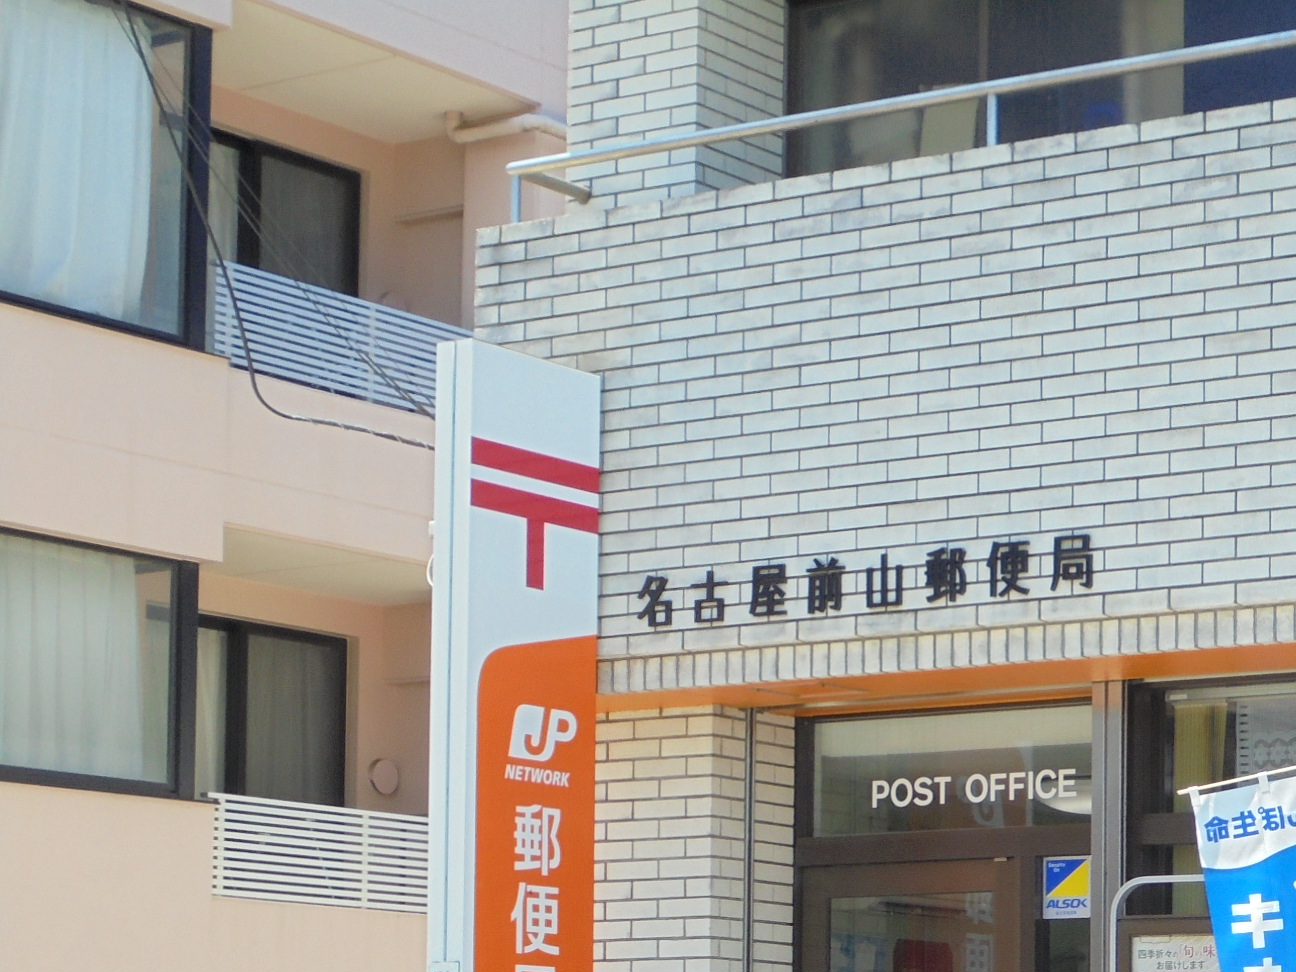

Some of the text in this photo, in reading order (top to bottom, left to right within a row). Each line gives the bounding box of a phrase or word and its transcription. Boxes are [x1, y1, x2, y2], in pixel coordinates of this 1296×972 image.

[637, 534, 1094, 628] 名古屋前山郵便局
[504, 764, 571, 788] NETWORK
[871, 768, 1077, 809] POST OFFICE
[1046, 898, 1088, 909] ALSOK
